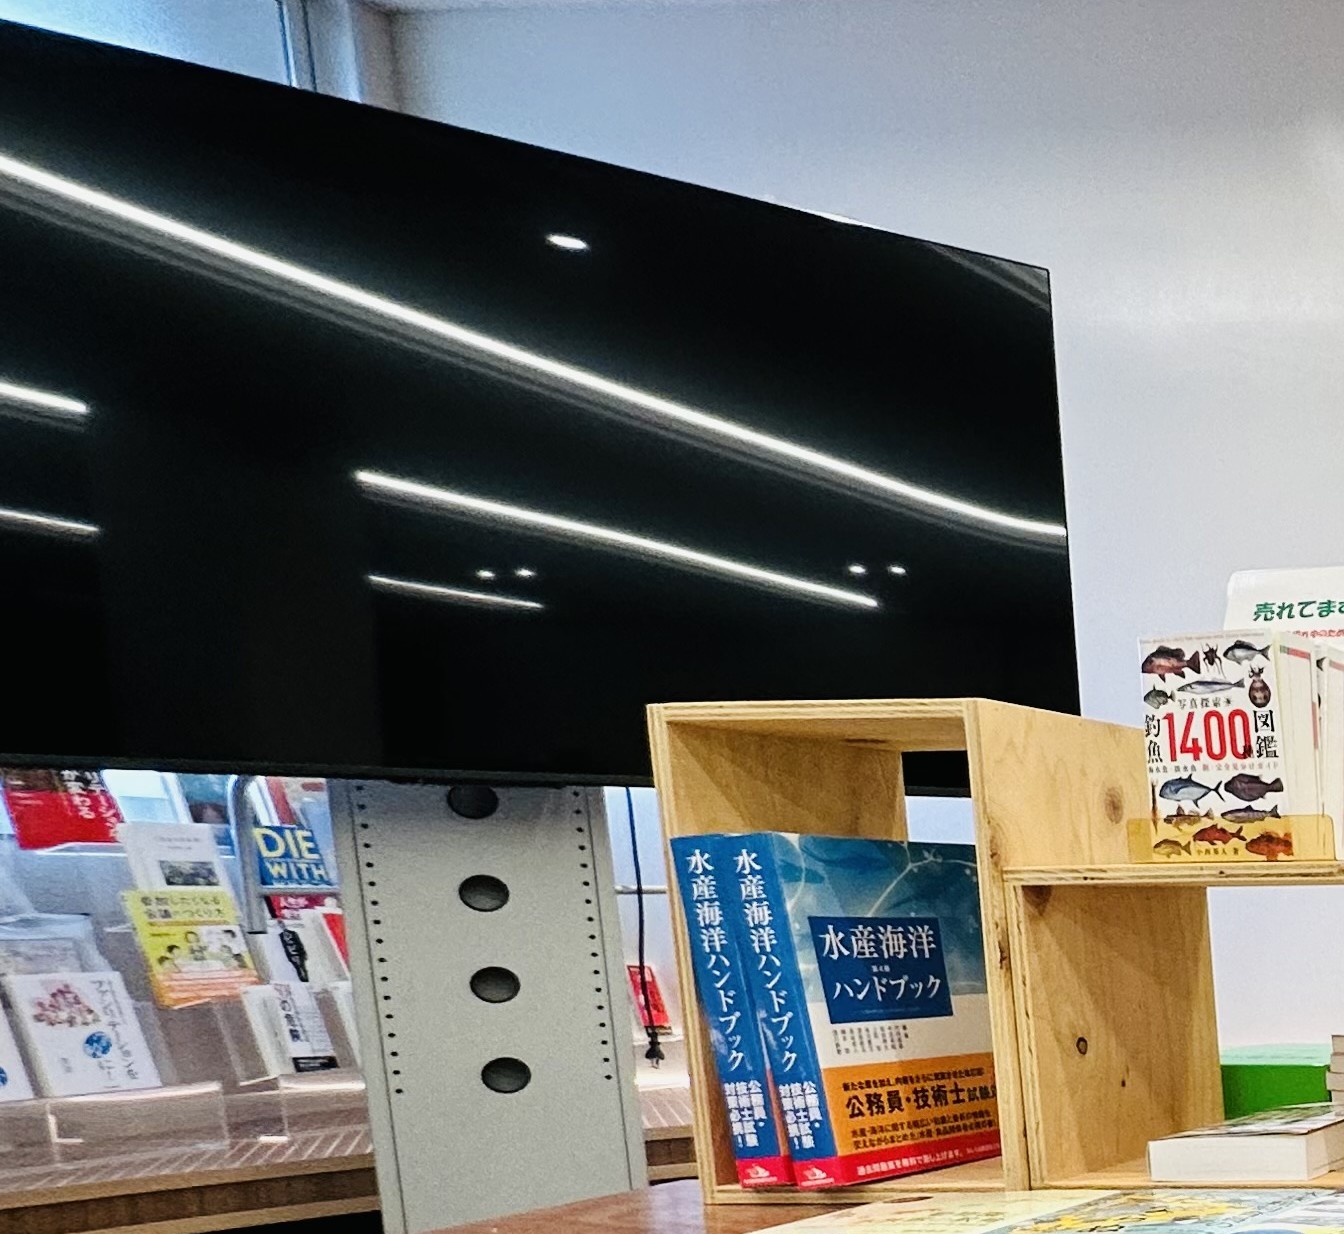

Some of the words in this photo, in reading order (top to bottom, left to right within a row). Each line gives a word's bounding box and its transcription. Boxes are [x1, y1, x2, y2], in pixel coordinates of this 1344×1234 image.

[1145, 714, 1163, 764] 釣魚
[1162, 709, 1253, 762] 1400
[1253, 710, 1279, 758] 図鑑
[254, 827, 322, 860] DIE
[265, 861, 329, 882] WITH
[686, 849, 745, 1072] 水産海洋ハンドブック
[734, 849, 797, 1073] 水産海洋ハンドブック
[818, 924, 937, 960] 水産海洋
[833, 974, 941, 1002] ハンドブック
